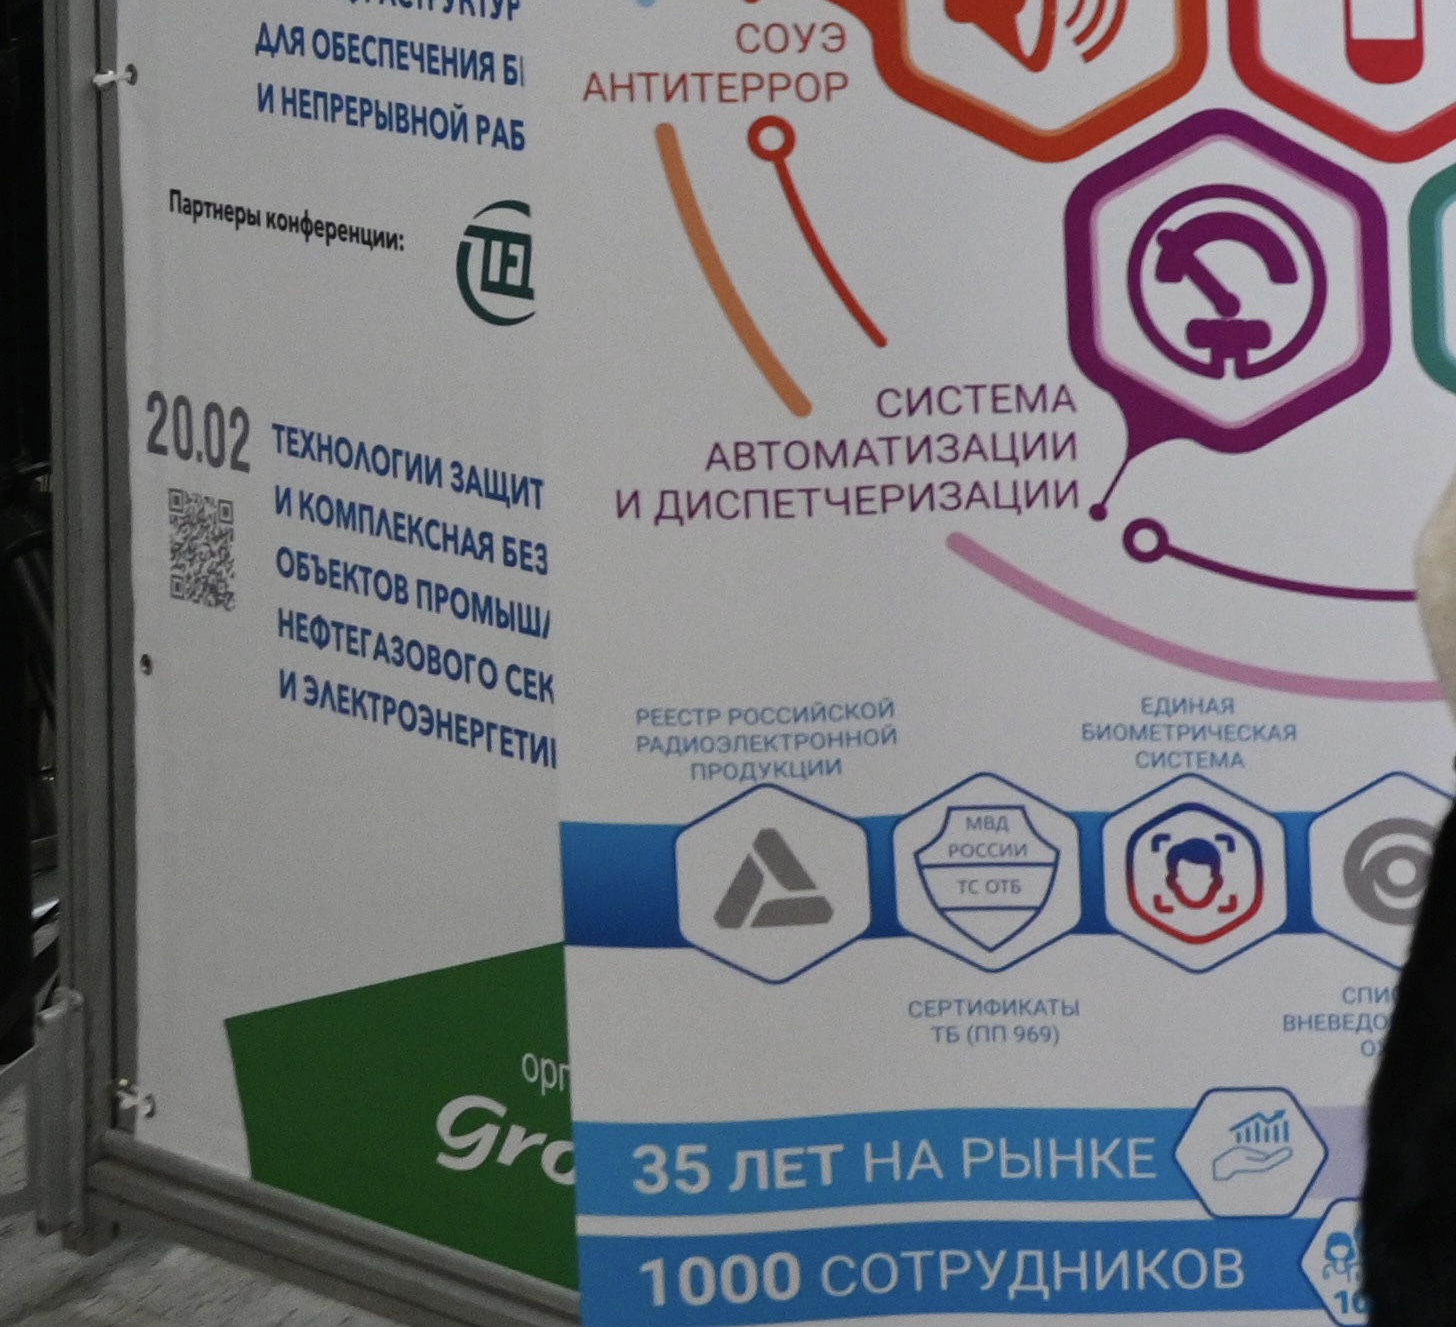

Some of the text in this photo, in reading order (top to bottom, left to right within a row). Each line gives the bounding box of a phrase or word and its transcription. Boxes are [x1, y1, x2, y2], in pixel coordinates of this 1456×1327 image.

[255, 22, 524, 87] ДЛЯ ОБЕСПЕЧЕНИЯ Б
[736, 23, 846, 53] СОУЭ
[583, 72, 849, 103] АНТИТЕРРОР
[257, 83, 525, 152] И НЕПРЕРЫВНОЙ РАБ
[169, 188, 404, 252] Партнеры конференции:
[877, 384, 1077, 419] СИСТЕМА
[147, 390, 251, 473] 20.02
[271, 422, 543, 510] ТЕХНОЛОГИИ ЗАЩИТ
[705, 432, 1078, 473] АВТОМАТИЗАЦИИ
[615, 480, 1079, 527] И ДИСПЕТЧЕРИЗАЦИИ
[275, 485, 548, 575] И КОМПЛЕКСНАЯ БЕЗ
[276, 547, 408, 605] ОБЪЕКТОВ
[278, 608, 498, 690] НЕФТЕГАЗОВОГО
[280, 669, 557, 769] И ЭЛЕКТРОЭНЕРГЕТИ
[636, 697, 895, 726] РЕЕСТР РОССИЙСКОЙ
[1141, 697, 1235, 717] ЕДИНАЯ
[636, 724, 898, 756] РАДИОЭЛЕКТРОННОЙ
[1082, 723, 1296, 742] БИОМЕТРИЧЕСКАЯ
[691, 759, 842, 782] ПРОДУКЦИИ
[1135, 751, 1245, 769] СИСТЕМА
[966, 816, 1010, 832] МВД
[948, 844, 1027, 858] РОССИИ
[957, 880, 1021, 894] ТС ОТБ
[908, 997, 1080, 1019] СЕРТИФИКАТЫ
[932, 1022, 1060, 1047] ТБ (ПП 969)
[632, 1136, 1157, 1194] 35 ЛЕТ НА РЫНКЕ
[639, 1247, 1246, 1307] 1000 СОТРУДНИКОВ
